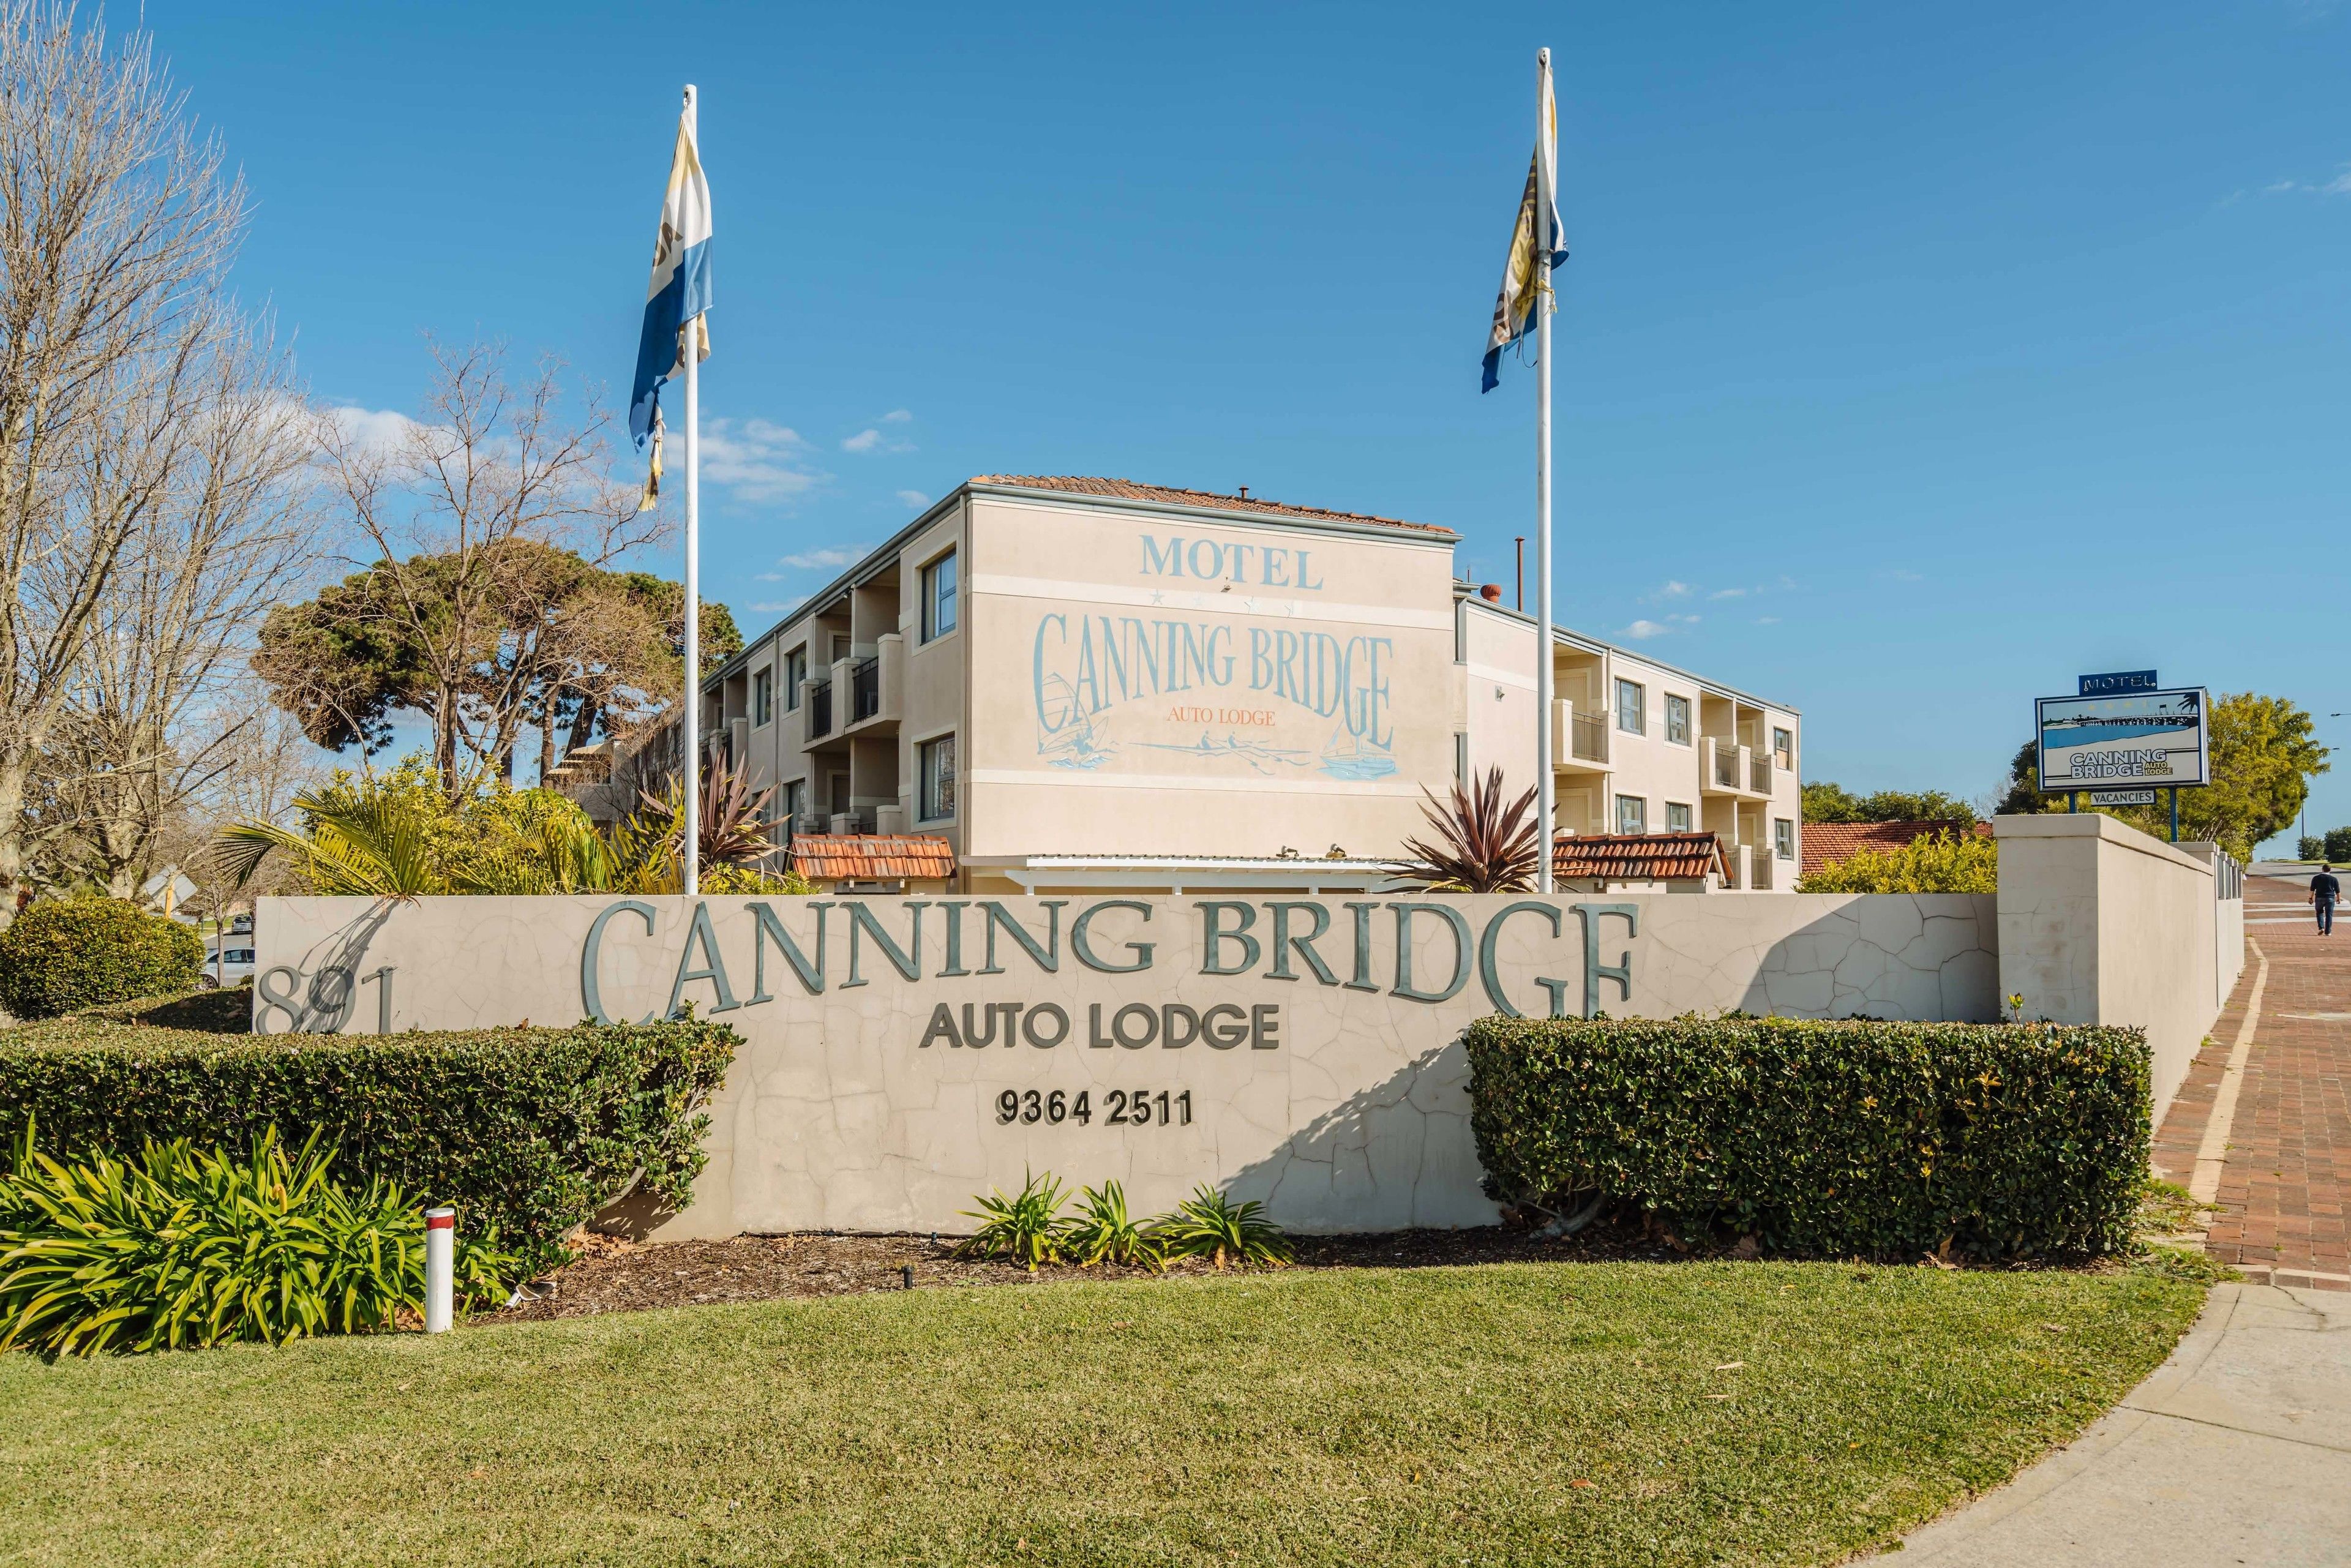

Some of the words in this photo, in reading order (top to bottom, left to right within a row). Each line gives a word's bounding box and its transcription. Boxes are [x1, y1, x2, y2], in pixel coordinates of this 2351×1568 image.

[1139, 535, 1324, 591] MOTEL
[1033, 613, 1236, 733] CANNING
[1248, 628, 1393, 751] BRIDGE
[2083, 675, 2156, 691] MOTEL
[1166, 706, 1213, 724] AUTO
[1218, 708, 1276, 727] LODGE
[2070, 749, 2167, 765] CANNING
[2071, 763, 2143, 779] BRIDGE
[2144, 767, 2173, 776] LODGE
[2093, 792, 2152, 803] VACANCIES
[580, 900, 1156, 1027] CANNING
[1194, 901, 1640, 1021] BRIDGE
[255, 965, 396, 1035] 891
[920, 1002, 1070, 1049] AUTO
[1089, 1002, 1280, 1050] LODGE
[998, 1089, 1092, 1126] 9364
[1109, 1089, 1191, 1126] 2511
